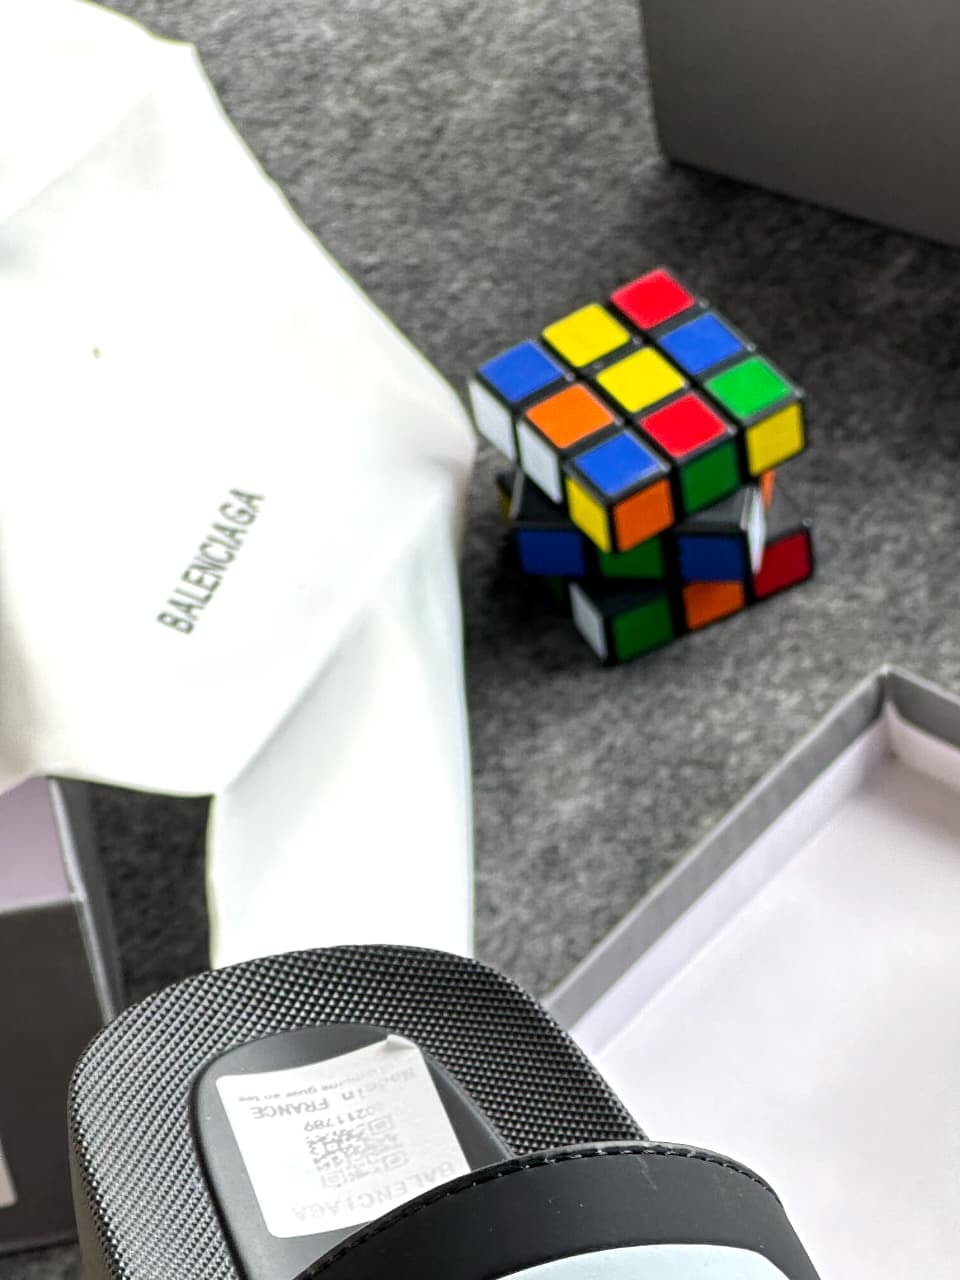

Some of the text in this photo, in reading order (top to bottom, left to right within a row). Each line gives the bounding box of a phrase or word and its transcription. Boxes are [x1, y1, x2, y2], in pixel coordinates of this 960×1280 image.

[157, 488, 266, 634] BALENCIAGA
[251, 1097, 330, 1119] FRANCE
[291, 1160, 457, 1221] BALENCIAGA
